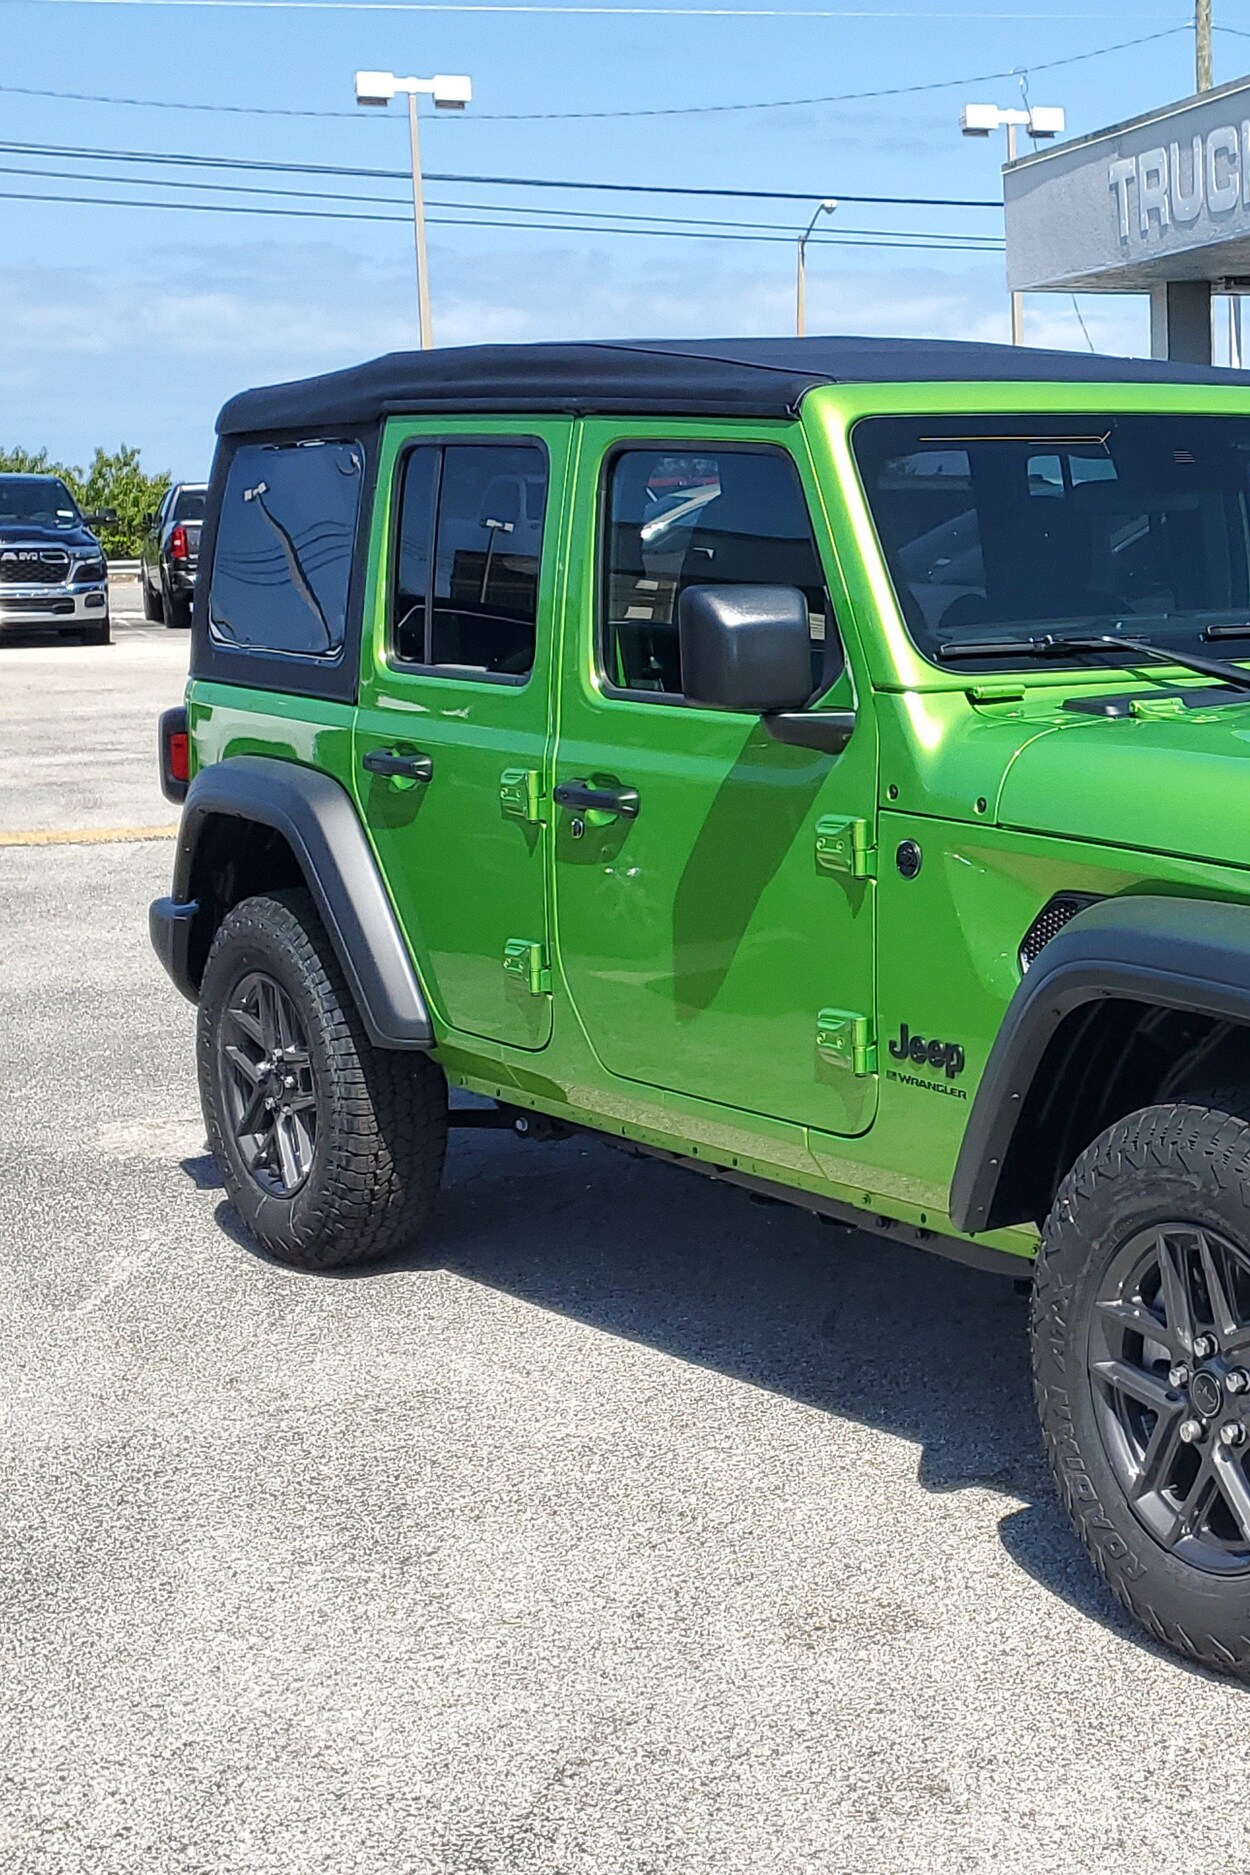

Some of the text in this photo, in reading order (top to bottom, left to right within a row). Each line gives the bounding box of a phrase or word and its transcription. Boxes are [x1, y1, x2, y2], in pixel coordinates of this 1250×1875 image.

[0, 551, 39, 561] AM
[888, 1022, 965, 1079] Jeep
[897, 1072, 967, 1100] WRANGLER
